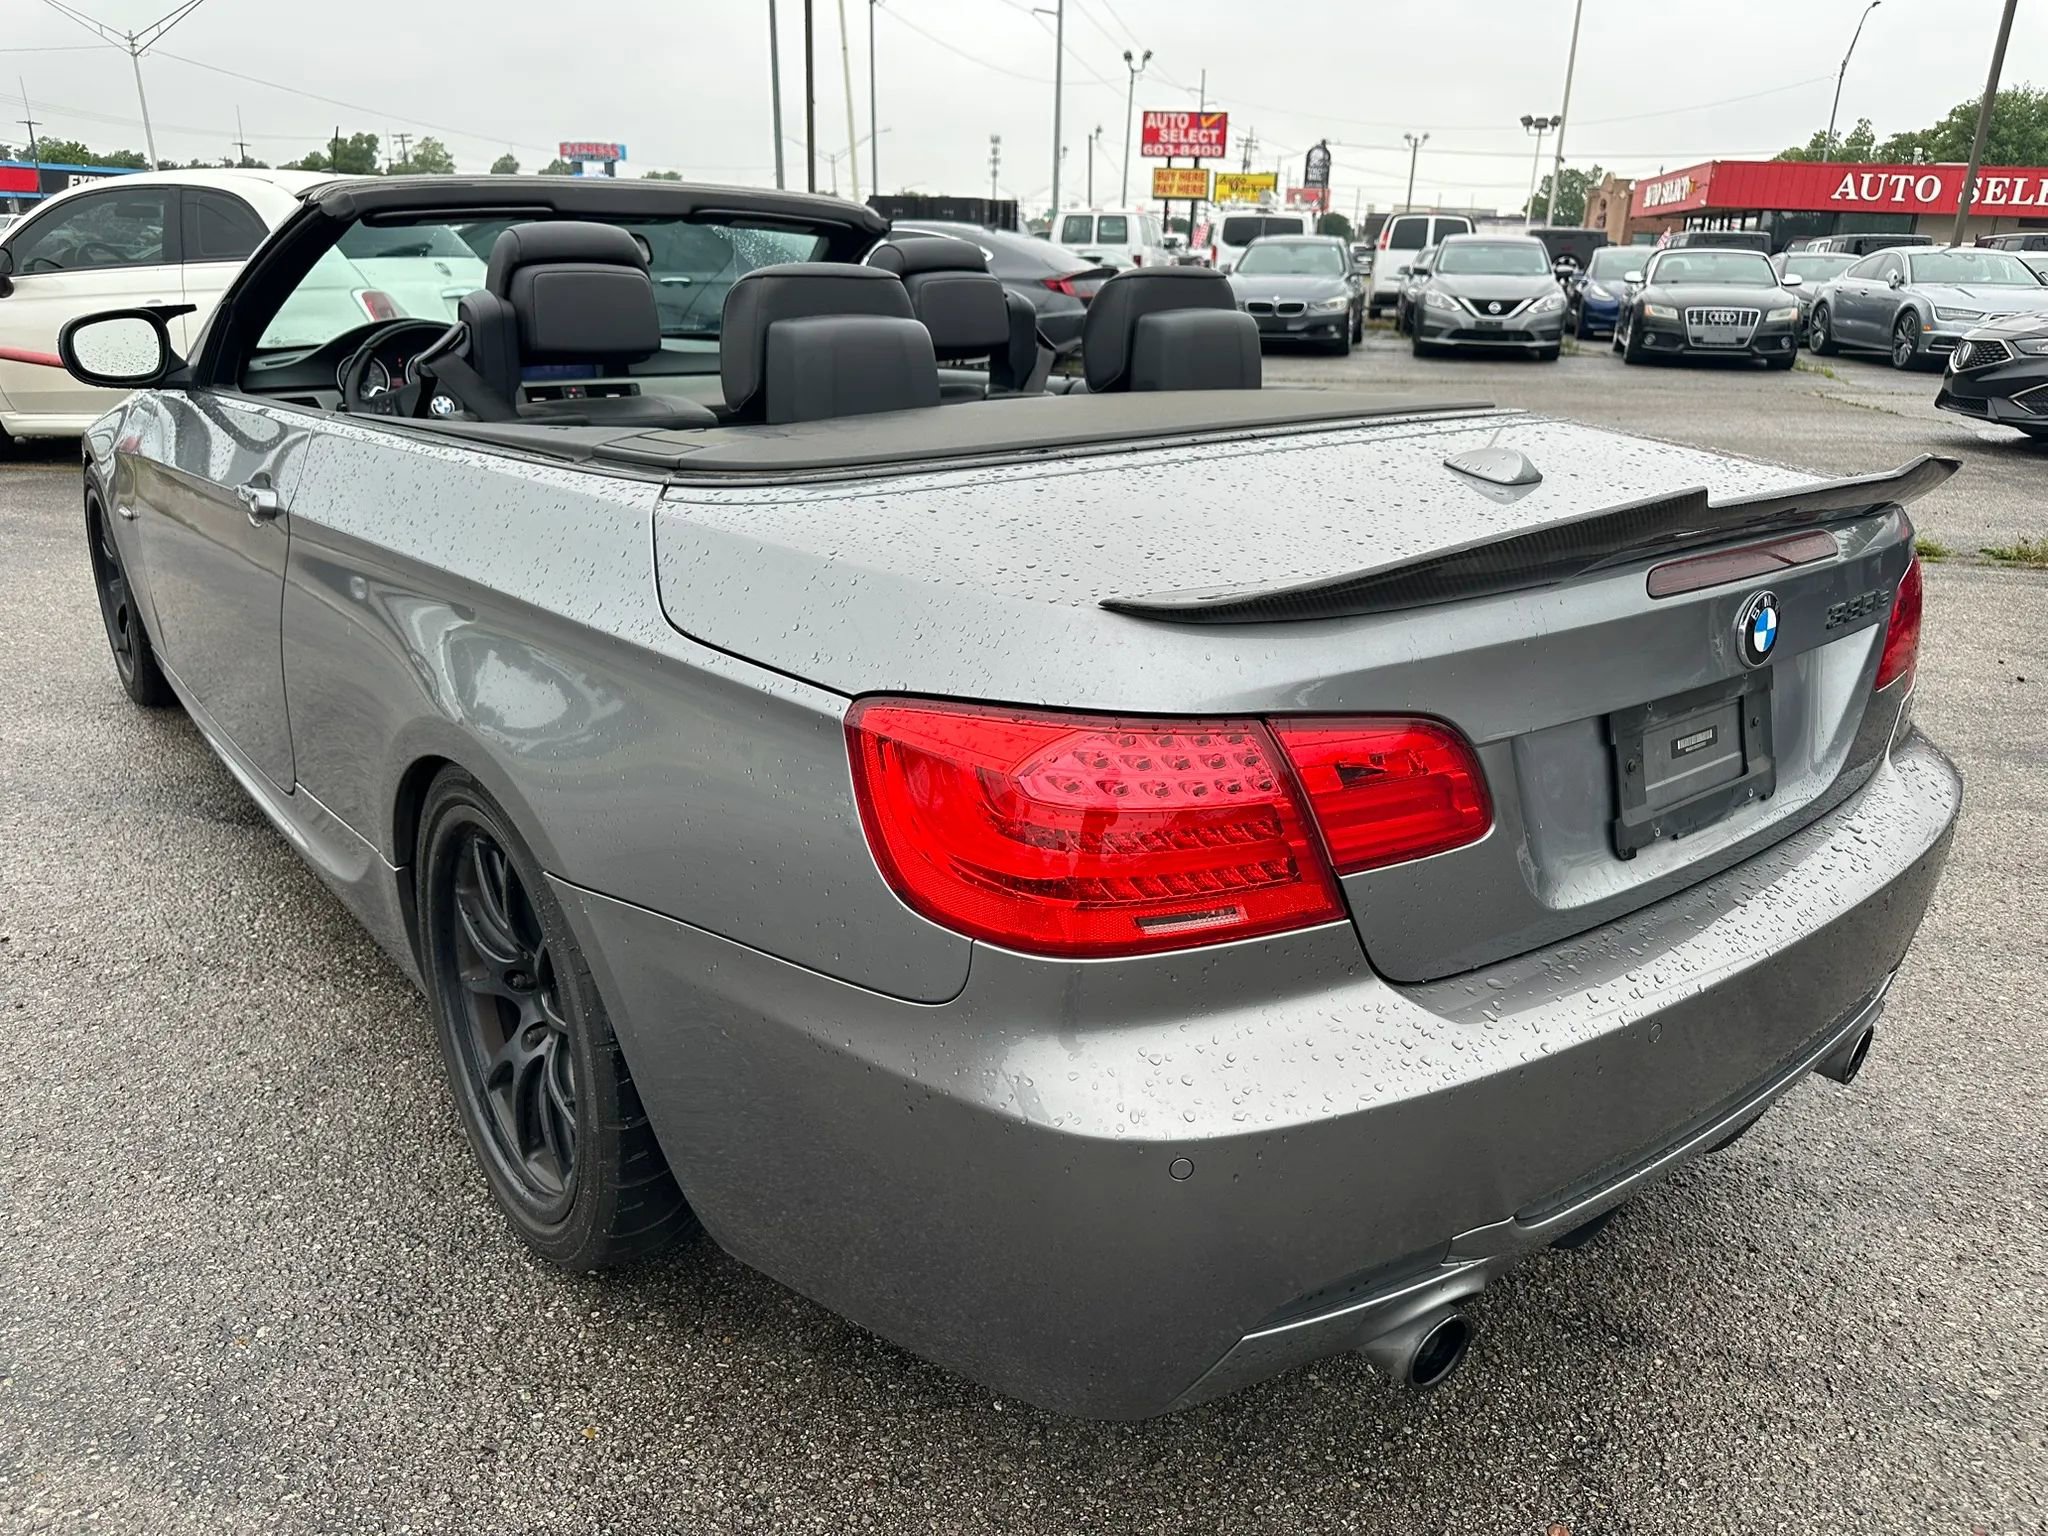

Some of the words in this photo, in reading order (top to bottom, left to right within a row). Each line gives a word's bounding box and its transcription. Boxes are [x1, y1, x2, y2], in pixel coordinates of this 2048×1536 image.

[1145, 113, 1190, 129] AUTO
[1158, 128, 1219, 144] SELECT
[560, 143, 618, 156] EXPRESS
[1143, 144, 1222, 156] 603-8400
[1156, 172, 1175, 182] BUY
[1179, 172, 1205, 183] HERE
[1156, 184, 1174, 194] PAY
[1178, 184, 1205, 195] HERE
[1831, 172, 1942, 202] AUTO
